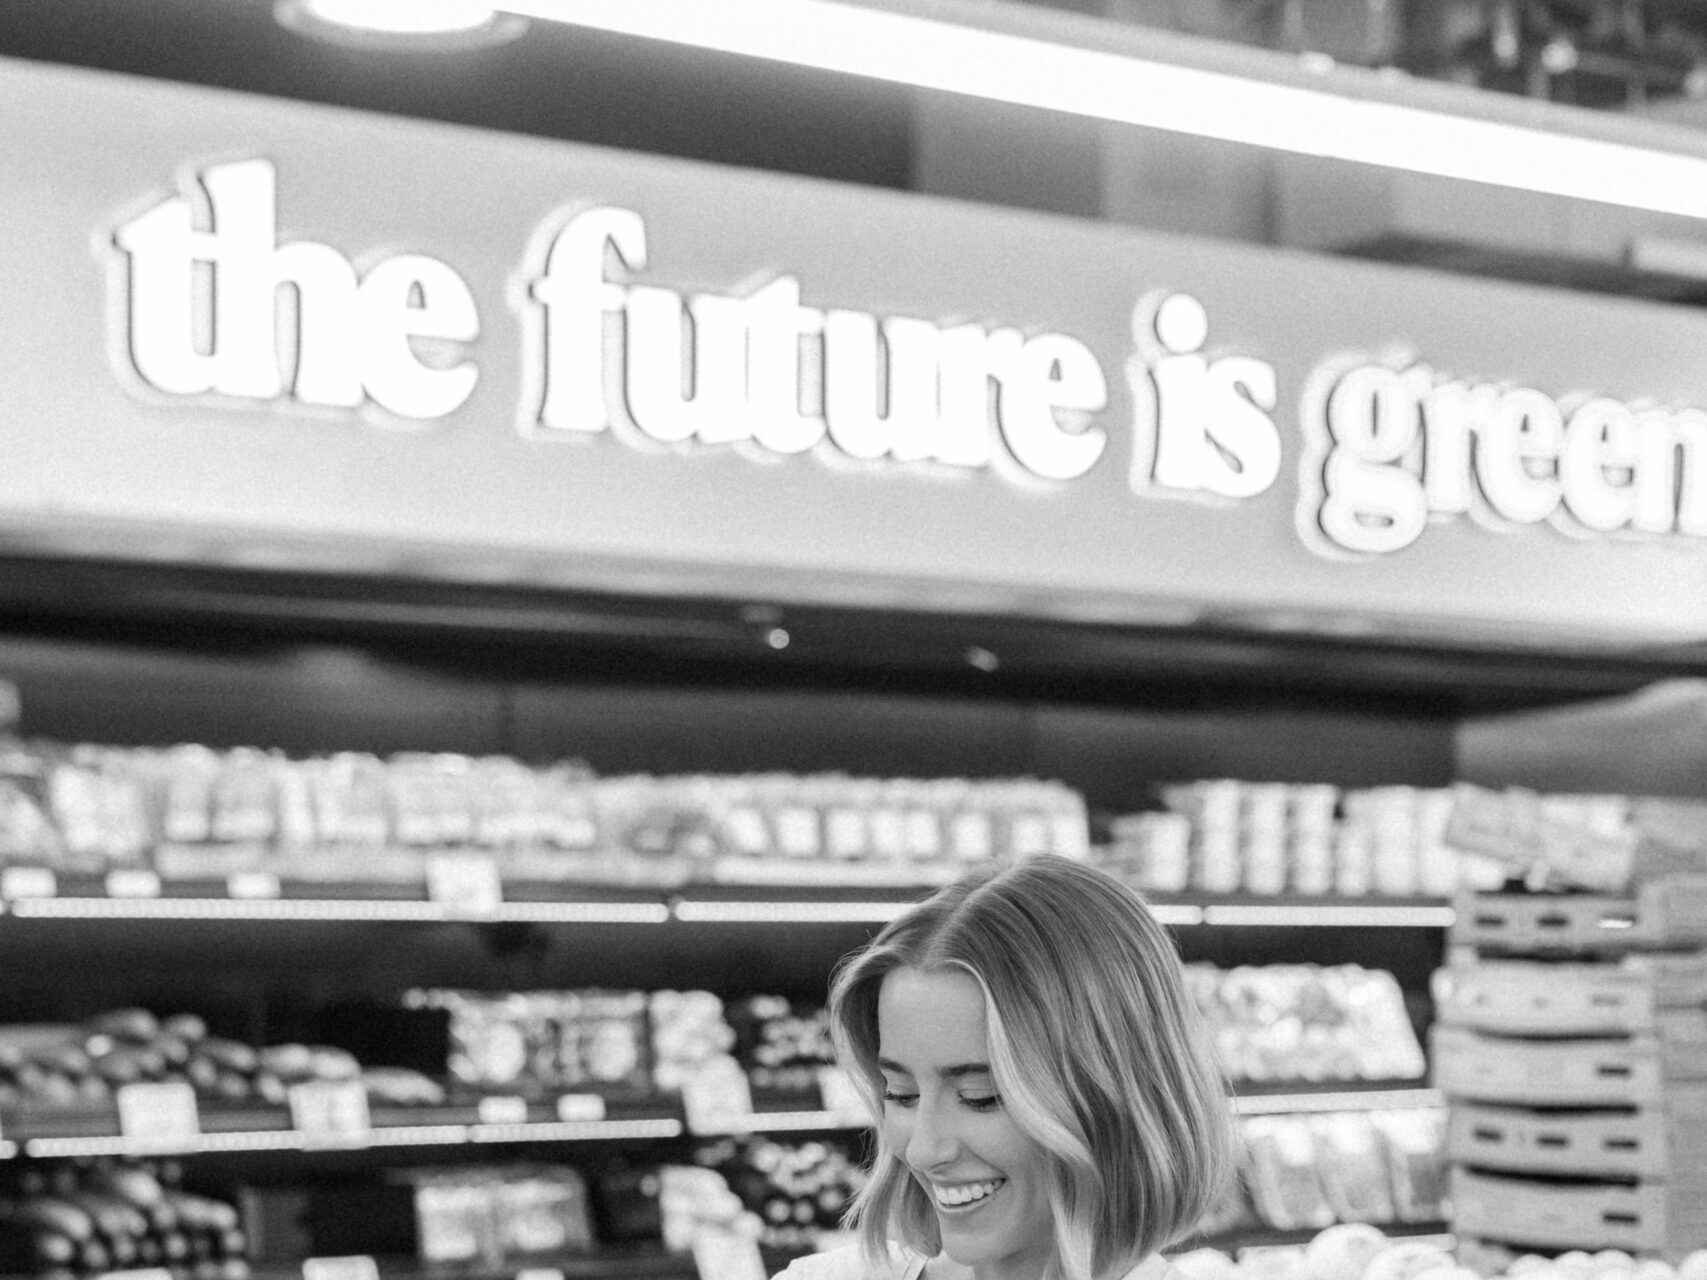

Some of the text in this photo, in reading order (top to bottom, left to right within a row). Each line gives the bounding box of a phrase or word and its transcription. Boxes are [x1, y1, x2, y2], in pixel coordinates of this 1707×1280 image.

[114, 159, 1707, 553] the future is green
